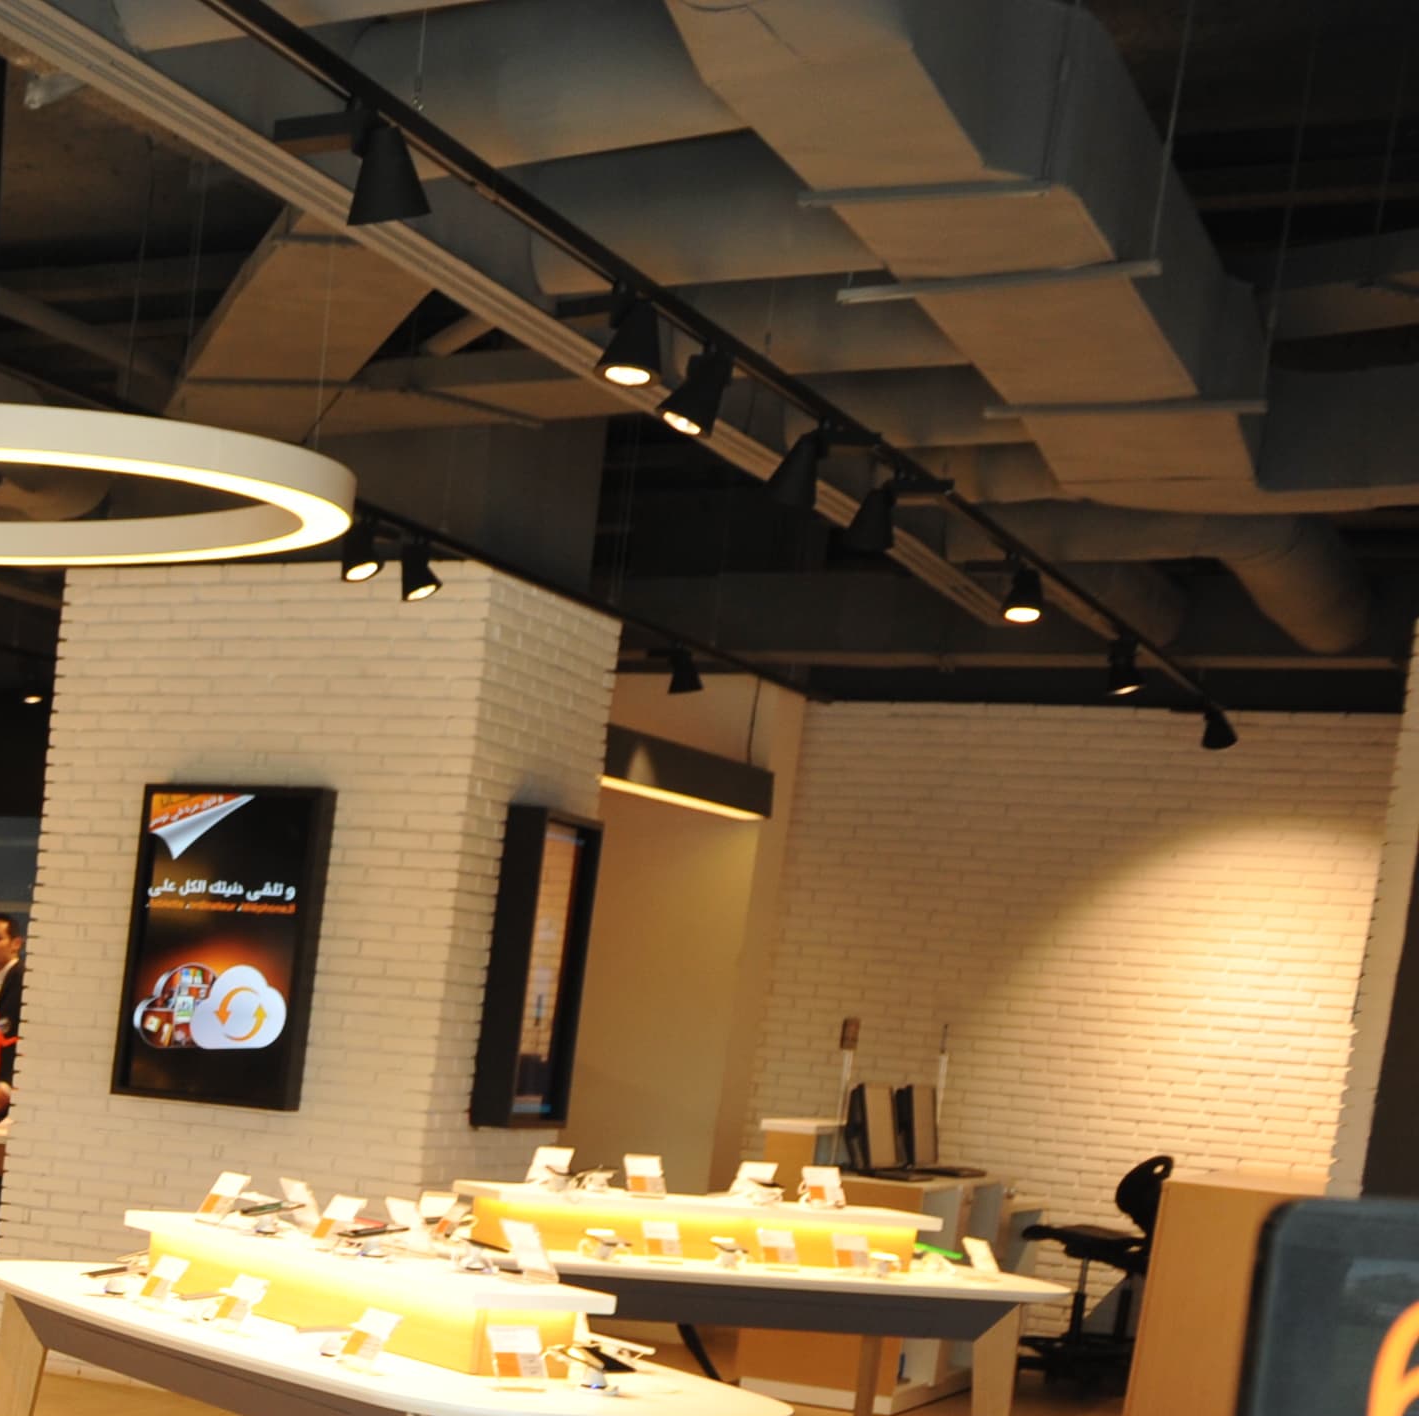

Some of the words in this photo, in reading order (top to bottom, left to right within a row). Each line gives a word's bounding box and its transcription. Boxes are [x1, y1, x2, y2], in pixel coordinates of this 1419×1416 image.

[147, 878, 176, 897] على
[178, 878, 207, 896] الكل
[285, 885, 297, 901] و
